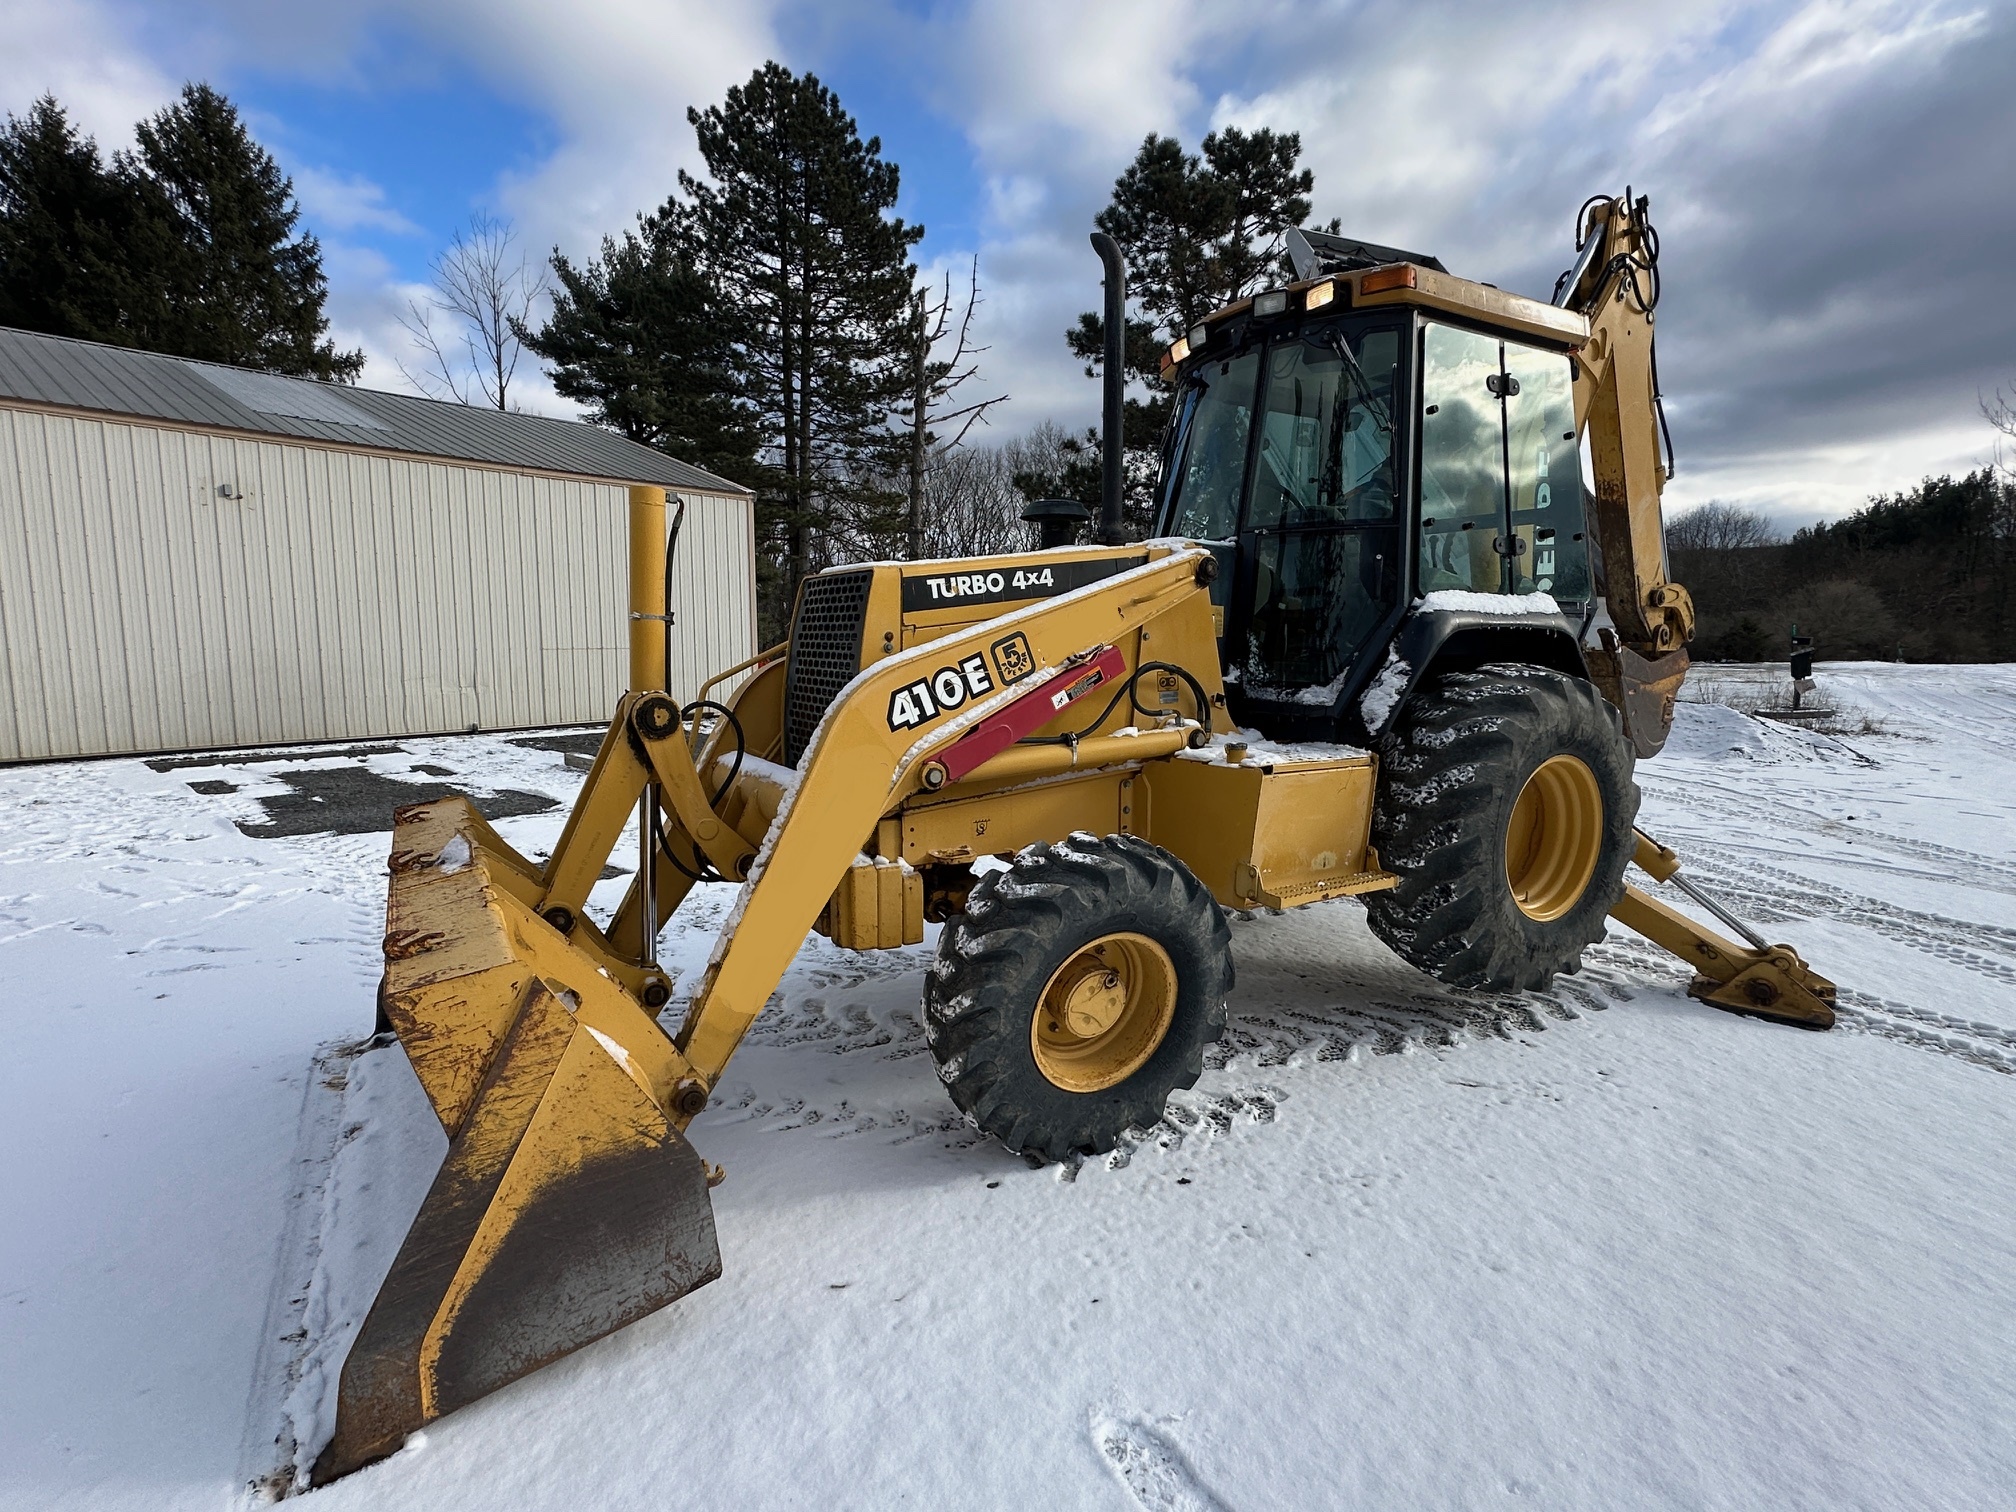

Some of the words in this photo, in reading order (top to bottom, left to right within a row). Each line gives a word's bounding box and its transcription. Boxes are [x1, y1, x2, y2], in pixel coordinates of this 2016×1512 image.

[926, 572, 1005, 599] TURBO
[1012, 568, 1054, 590] 4x4
[1002, 641, 1022, 668] 5
[1018, 651, 1028, 673] STAR
[890, 655, 992, 728] 410E
